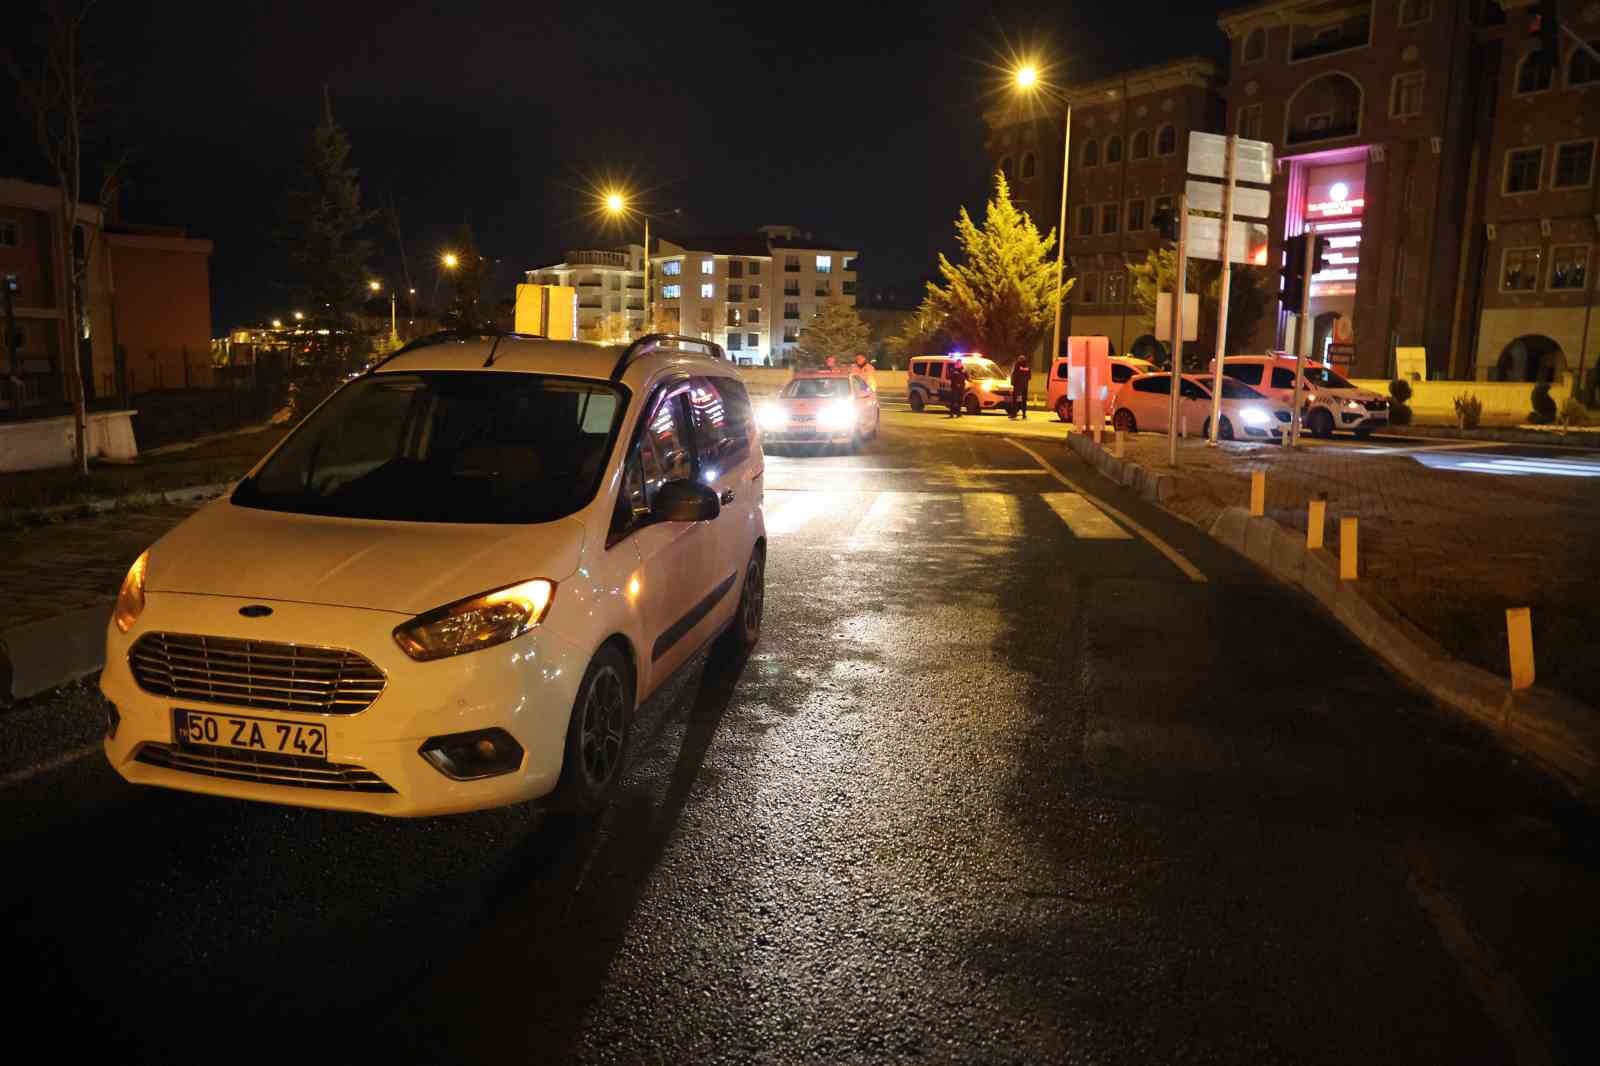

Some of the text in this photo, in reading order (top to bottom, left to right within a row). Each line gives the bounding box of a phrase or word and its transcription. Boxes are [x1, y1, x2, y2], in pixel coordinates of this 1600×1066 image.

[189, 715, 323, 755] 50 ZA 742
